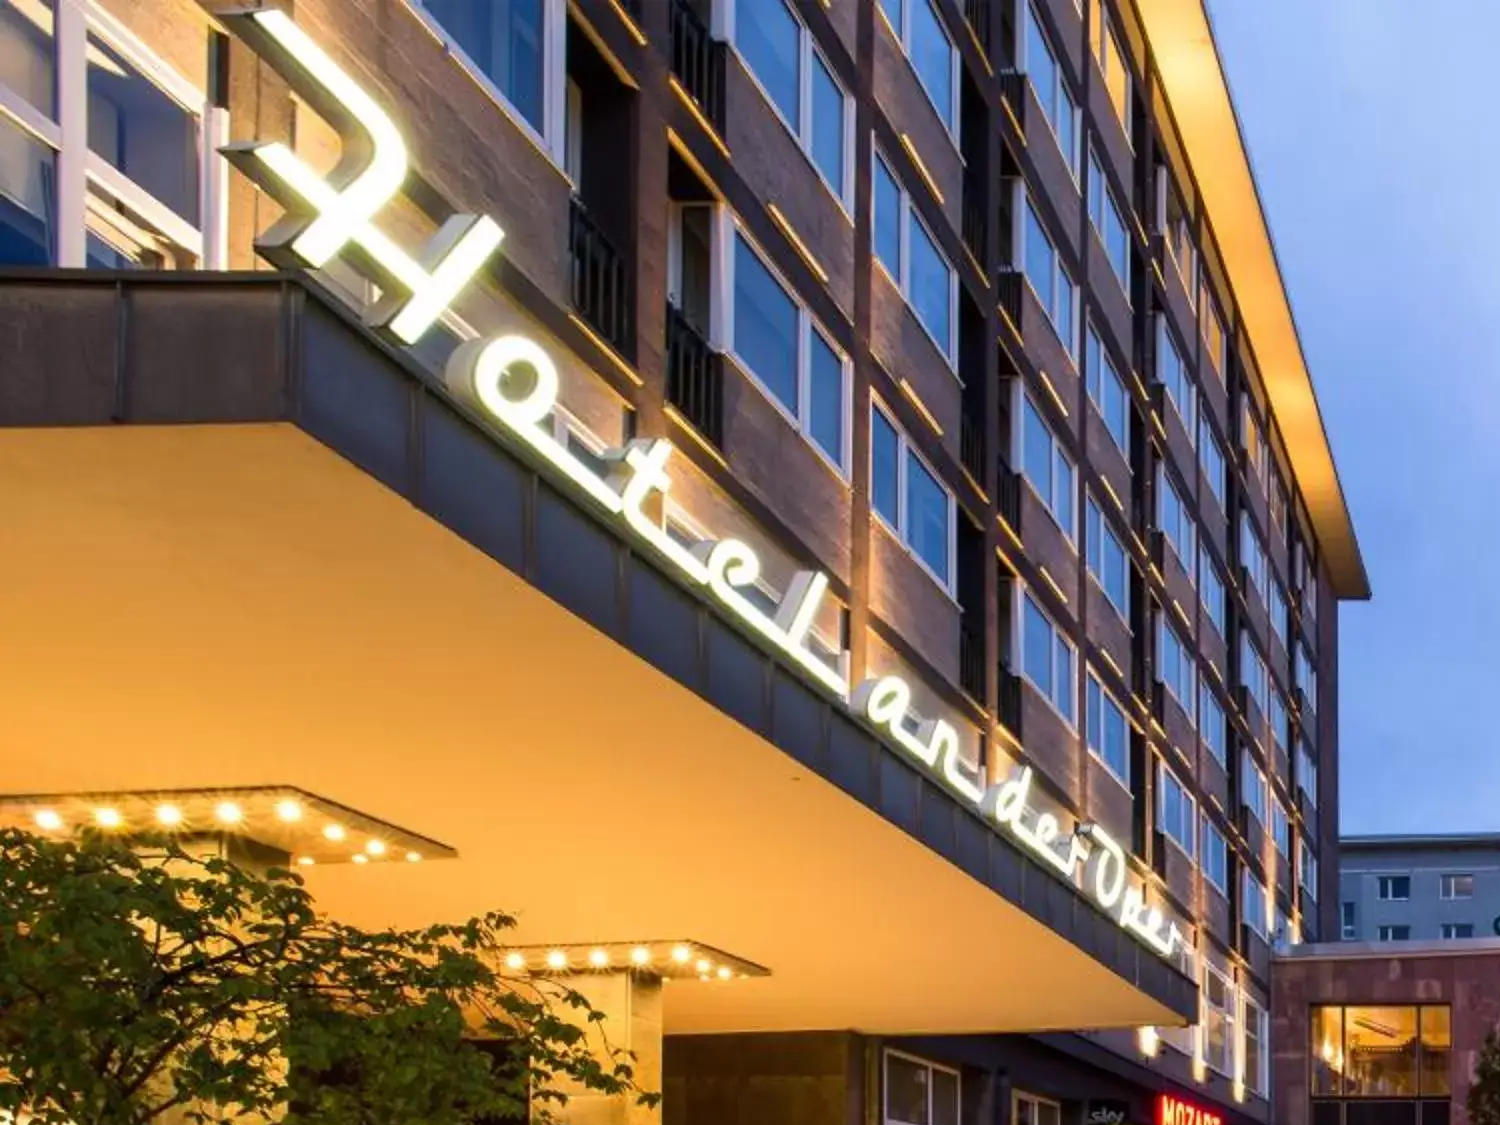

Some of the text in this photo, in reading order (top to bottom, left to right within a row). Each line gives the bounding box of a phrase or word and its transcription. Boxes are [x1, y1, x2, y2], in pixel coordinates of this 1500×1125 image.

[252, 8, 1182, 957] Hotel an der Oper
